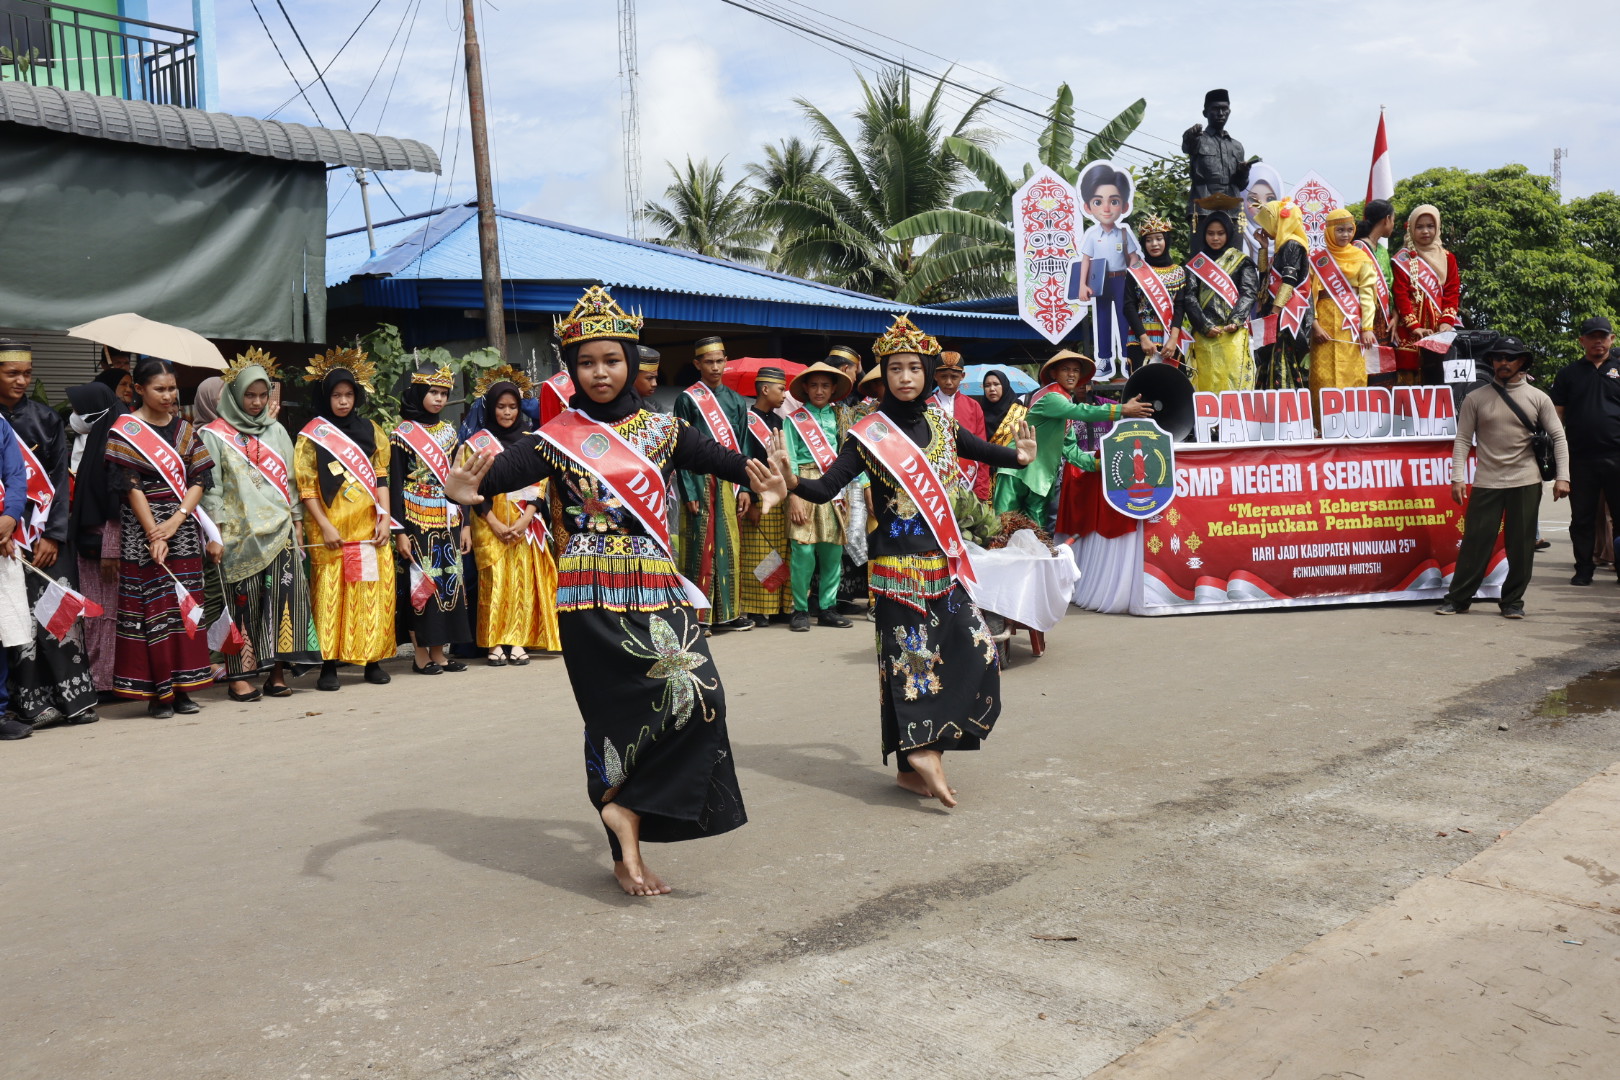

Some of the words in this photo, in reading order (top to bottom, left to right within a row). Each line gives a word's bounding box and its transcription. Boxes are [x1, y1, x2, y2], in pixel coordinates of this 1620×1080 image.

[1144, 277, 1170, 312] DAYAK
[1208, 269, 1238, 303] TIDUN
[1327, 271, 1359, 318] TORAJA
[1453, 369, 1467, 379] 14
[708, 410, 733, 448] BUGIS
[1193, 389, 1314, 443] PAWAI
[1321, 386, 1457, 440] BUDAYA
[422, 442, 449, 481] DAYA
[806, 428, 834, 467] MELAY
[262, 456, 288, 490] BUG
[342, 446, 376, 487] BUGIS
[1175, 466, 1224, 497] SMP
[1231, 463, 1302, 495] NEGERI
[1307, 462, 1318, 491] 1
[1323, 459, 1404, 490] SEBATIK
[900, 454, 947, 526] DAYAK
[1319, 498, 1435, 514] Kebersamaan
[1207, 517, 1319, 538] Melanjutkan
[1252, 546, 1275, 561] HARI
[1277, 544, 1299, 560] JADI
[1301, 542, 1350, 558] KABUPATEN
[1352, 539, 1397, 556] NUNUKAN
[1398, 538, 1416, 553] 25TH
[1293, 564, 1347, 578] #CINTANUNUKAN
[1348, 562, 1382, 575] #HUT25TH
